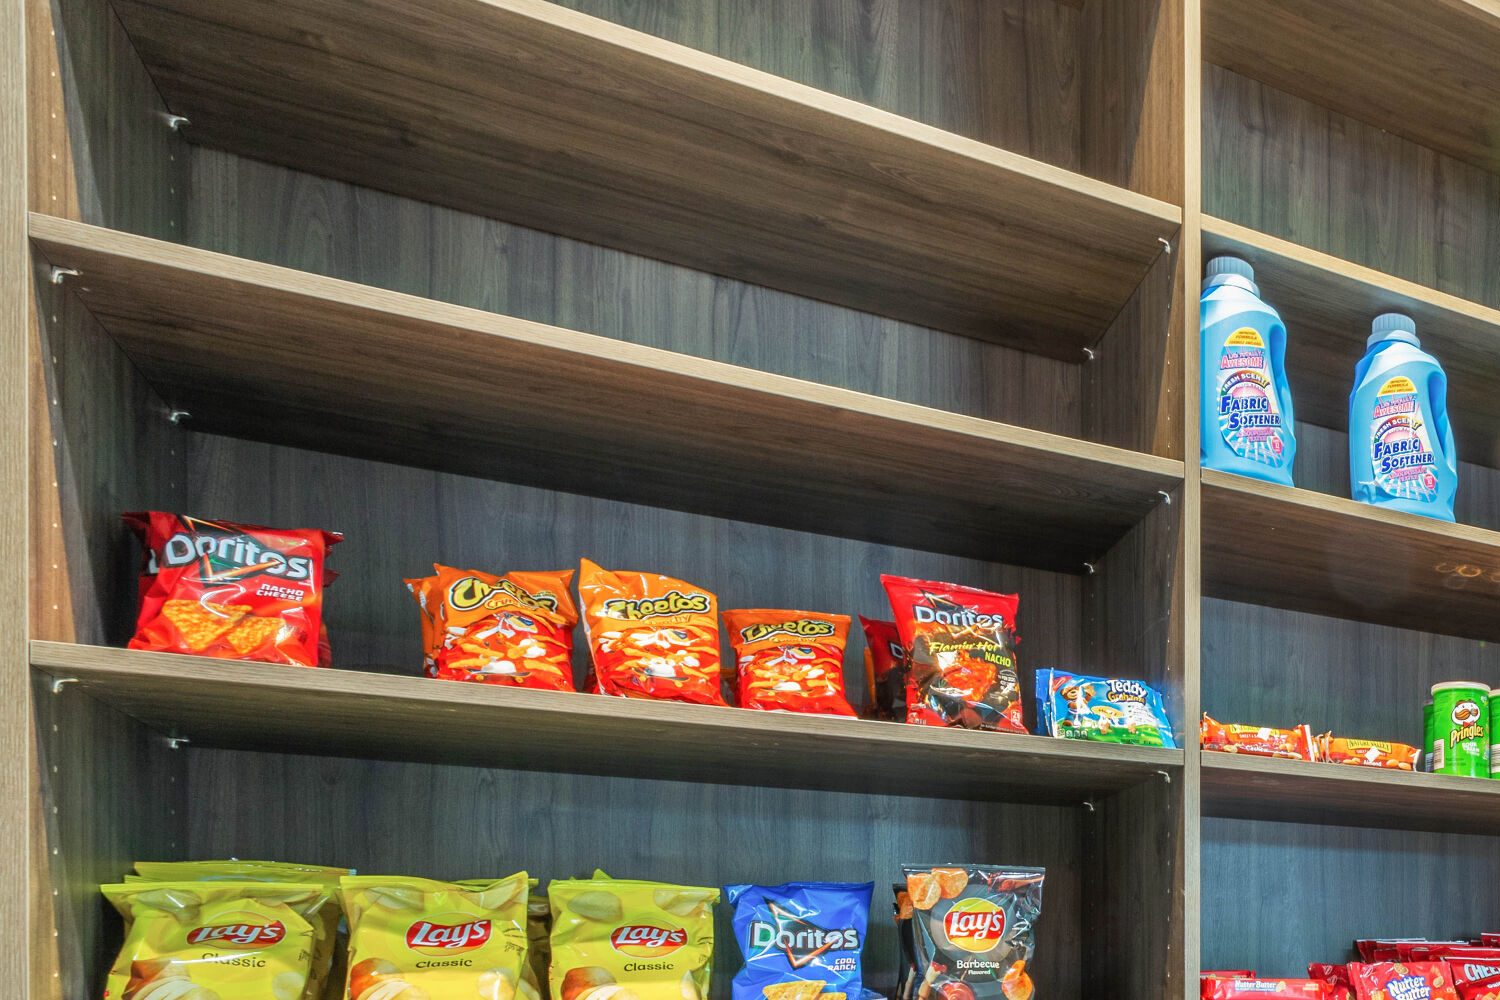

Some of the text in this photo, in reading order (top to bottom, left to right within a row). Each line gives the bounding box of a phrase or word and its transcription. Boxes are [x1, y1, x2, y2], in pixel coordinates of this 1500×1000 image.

[1221, 396, 1268, 413] FABRIC
[1229, 413, 1280, 429] SOFTENER
[1374, 439, 1419, 459] FABRIC
[1381, 453, 1432, 473] SOFTENER
[165, 533, 309, 579] Doritos
[261, 584, 304, 597] NACHO
[916, 605, 1003, 628] Doritos
[984, 652, 1012, 668] NACHO
[1107, 680, 1149, 698] Teddy
[1450, 724, 1484, 749] Pringles
[414, 920, 492, 948] Lay's
[949, 910, 1002, 941] Lay's
[617, 925, 683, 948] Lay's
[752, 923, 858, 949] Doritos
[415, 957, 473, 969] Classic
[624, 961, 675, 972] Classic
[956, 959, 1000, 969] Barbecue
[1235, 980, 1277, 989] Nutter Butter
[1388, 976, 1425, 998] Nutter
